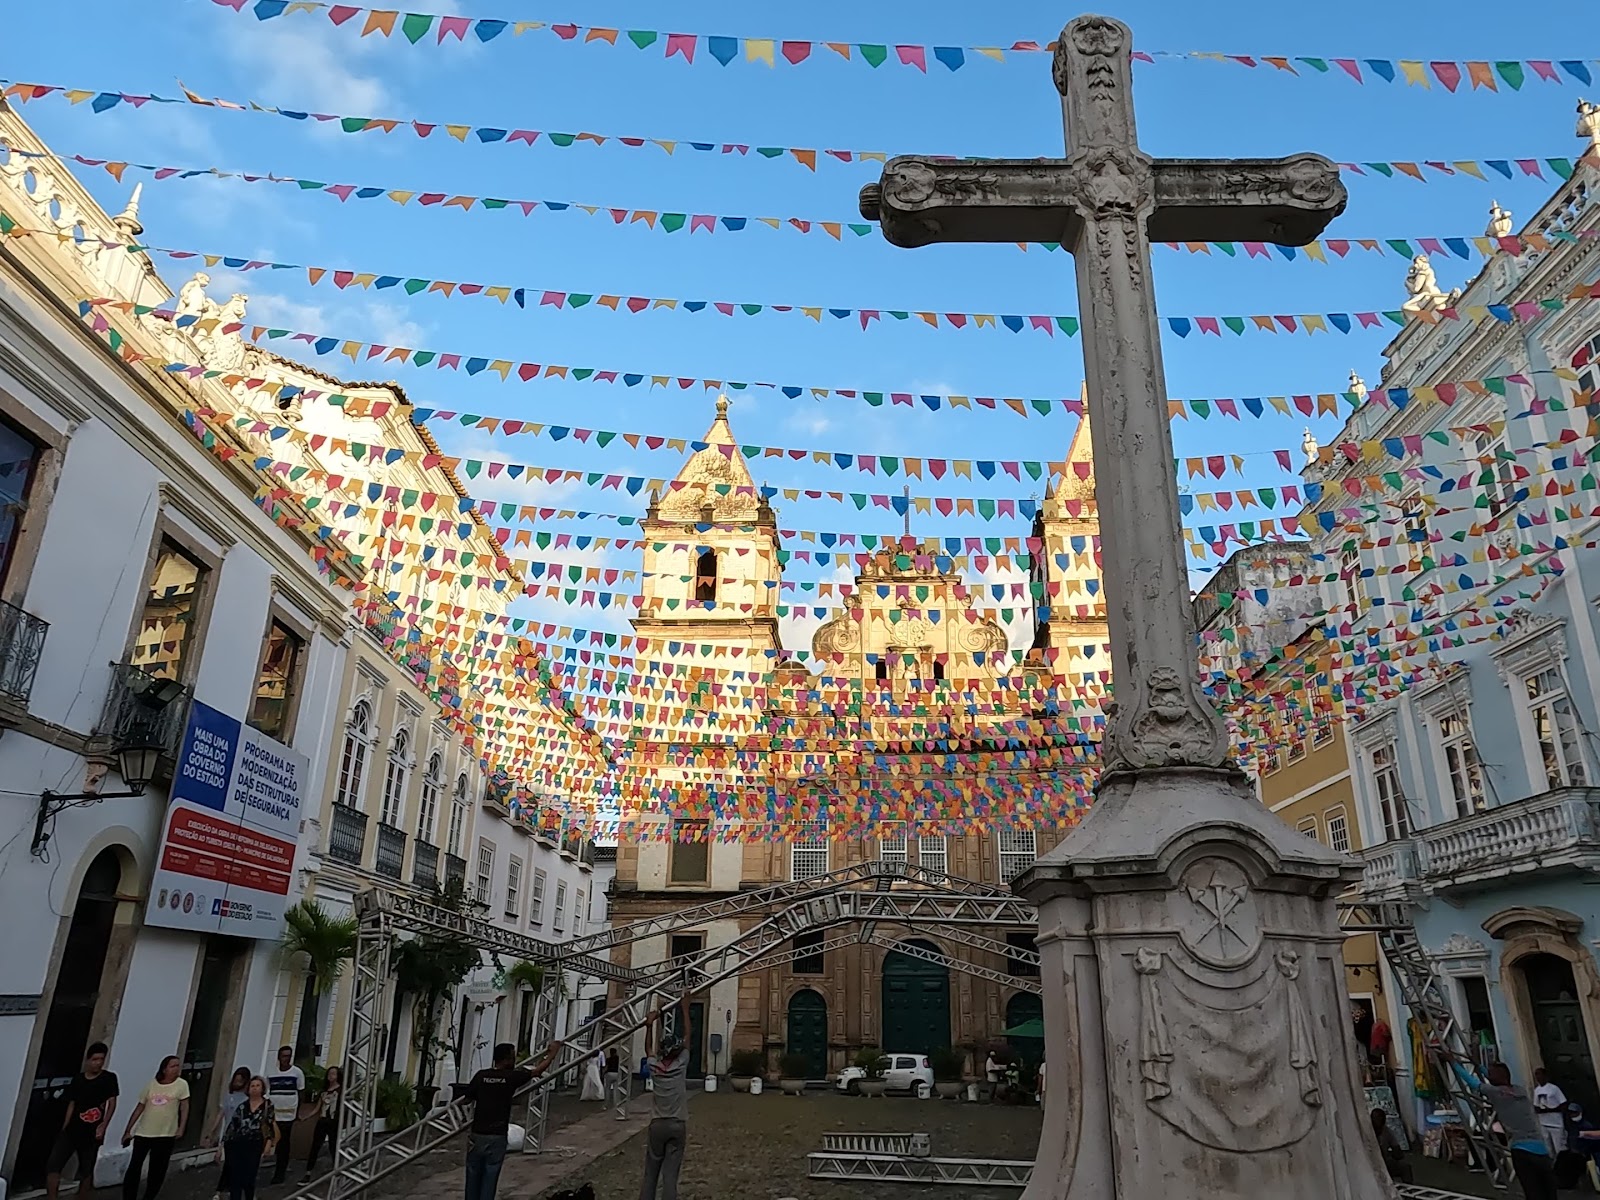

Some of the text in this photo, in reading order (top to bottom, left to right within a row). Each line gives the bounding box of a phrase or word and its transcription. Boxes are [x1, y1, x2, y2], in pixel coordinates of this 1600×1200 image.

[193, 741, 226, 763] OBRA DO
[194, 727, 229, 752] MAIS UMA
[189, 753, 225, 776] GOVERNO
[245, 741, 295, 775] PROGRAMA DE
[183, 764, 225, 789] DO ESTADO
[241, 757, 297, 792] MODERNIZAÇÃO
[237, 773, 300, 809] DAS ESTRUTURAS
[234, 789, 290, 820] DE SEGURANÇA
[227, 910, 236, 918] DO
[235, 911, 252, 920] ESTADO
[229, 902, 252, 912] GOVERNO
